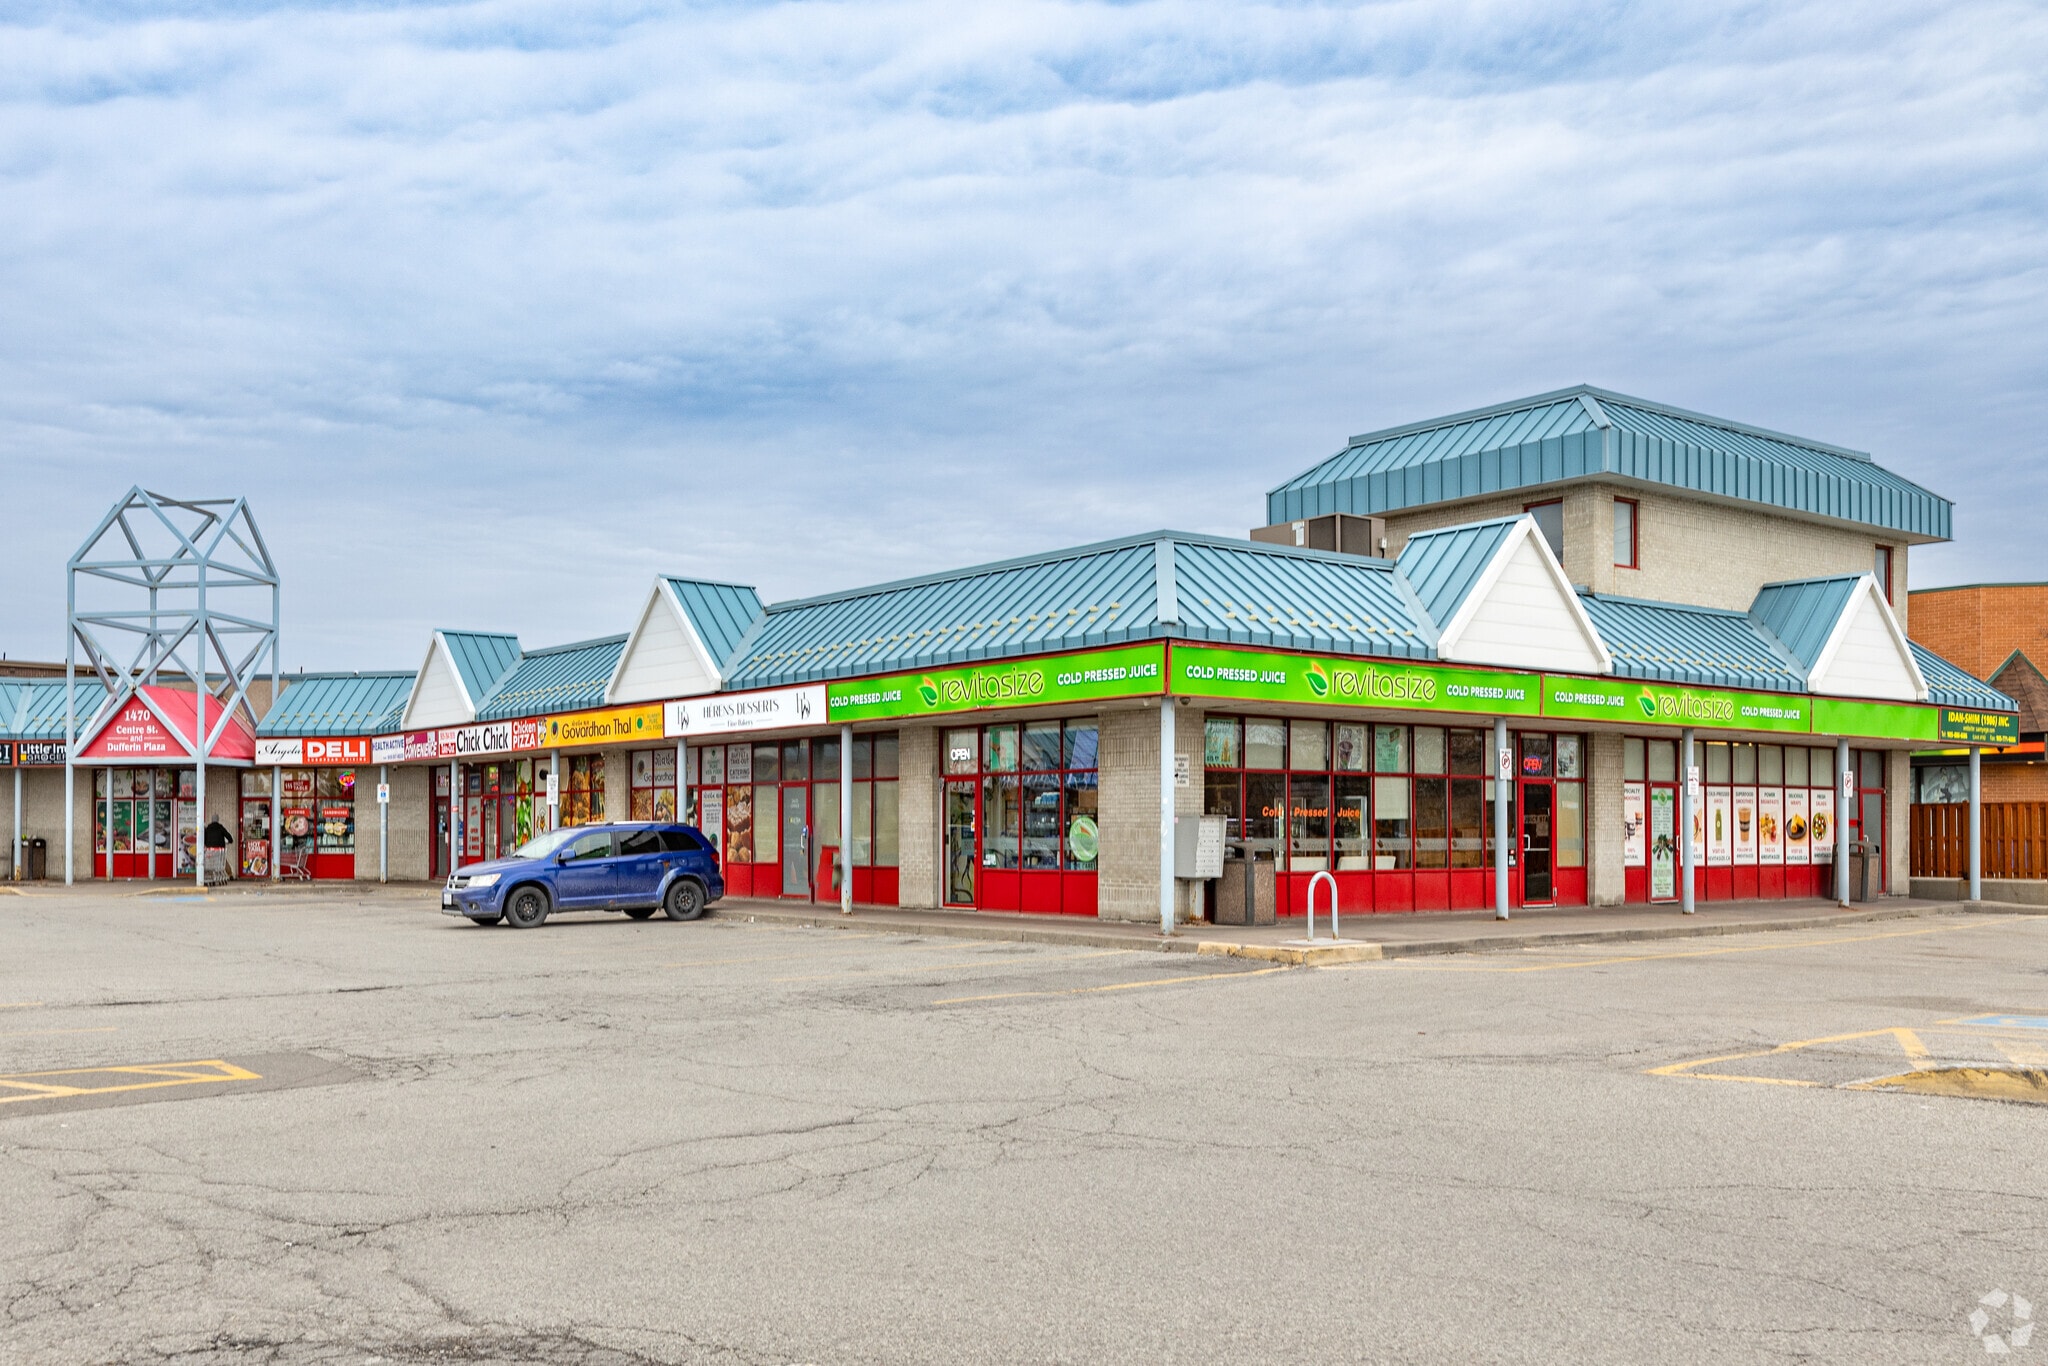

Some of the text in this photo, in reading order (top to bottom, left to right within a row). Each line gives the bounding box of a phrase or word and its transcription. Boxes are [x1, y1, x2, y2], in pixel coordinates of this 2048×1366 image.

[1057, 664, 1157, 686] COLD PRESSED JUICE
[1186, 665, 1286, 684] COLD PRESSED JUICE
[940, 667, 1044, 702] revitasize
[1333, 666, 1436, 701] revitasize
[830, 690, 902, 707] COLD PRESSED JUICE
[1446, 684, 1525, 701] COLD PRESSED JUICE
[1554, 691, 1625, 707] COLD PRESSED JUICE
[736, 699, 780, 714] DESSERTS
[1657, 689, 1734, 720] revitasize
[124, 709, 151, 721] 1470
[1740, 705, 1801, 720] COLD PRESSED JUICE
[116, 724, 158, 734] Centre St.
[512, 720, 536, 734] Chicken
[562, 716, 632, 740] Govardhan Thal
[130, 734, 143, 742] and
[457, 726, 508, 752] Chick Chick
[513, 733, 535, 748] PIZZA
[107, 742, 166, 752] Dufferin Plaza
[307, 740, 366, 758] DELI
[950, 748, 970, 760] OPEN
[729, 767, 750, 776] CATERING
[1262, 806, 1360, 817] Cold Pressed Juice
